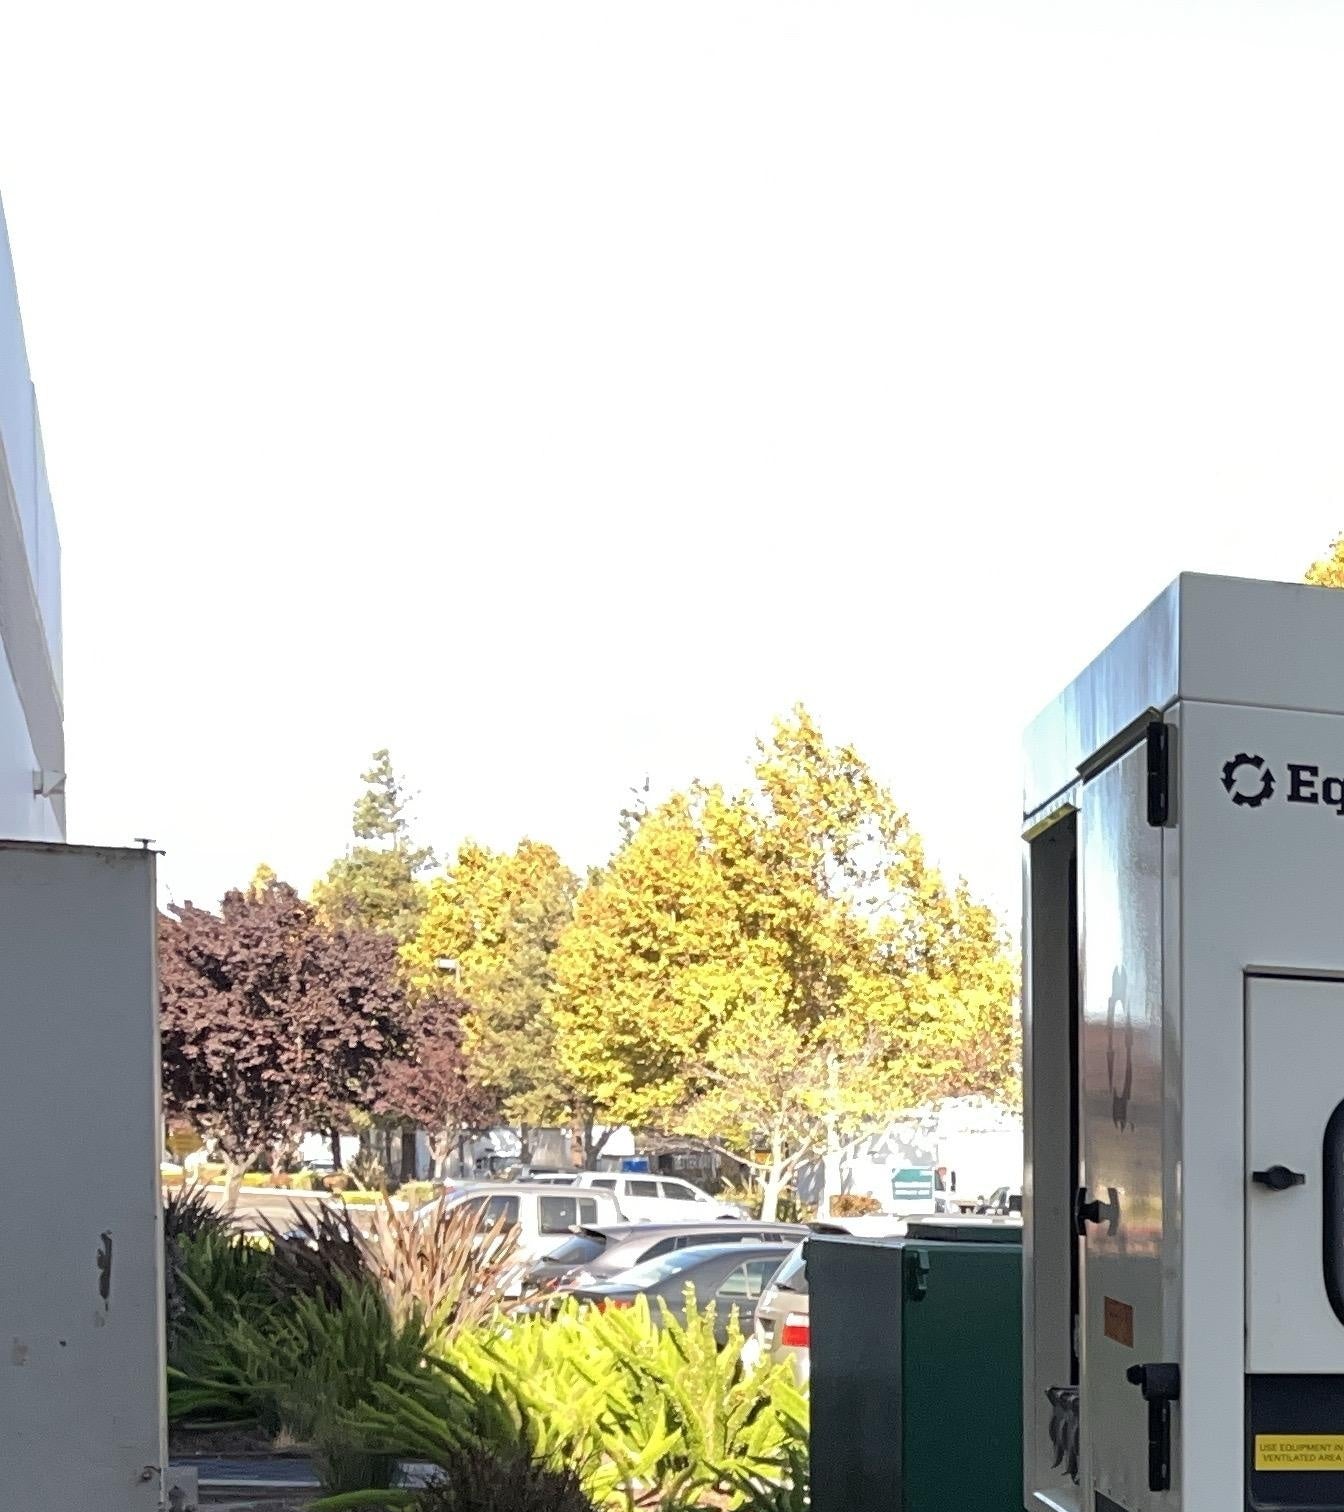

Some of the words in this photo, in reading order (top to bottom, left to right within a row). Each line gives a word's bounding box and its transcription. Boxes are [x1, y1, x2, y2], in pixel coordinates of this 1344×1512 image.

[1259, 1443, 1277, 1452] USE
[1279, 1443, 1332, 1452] EQUIPMENT
[1333, 1443, 1344, 1452] IN
[1263, 1453, 1317, 1462] VENTILATED
[1318, 1453, 1342, 1462] AREA
